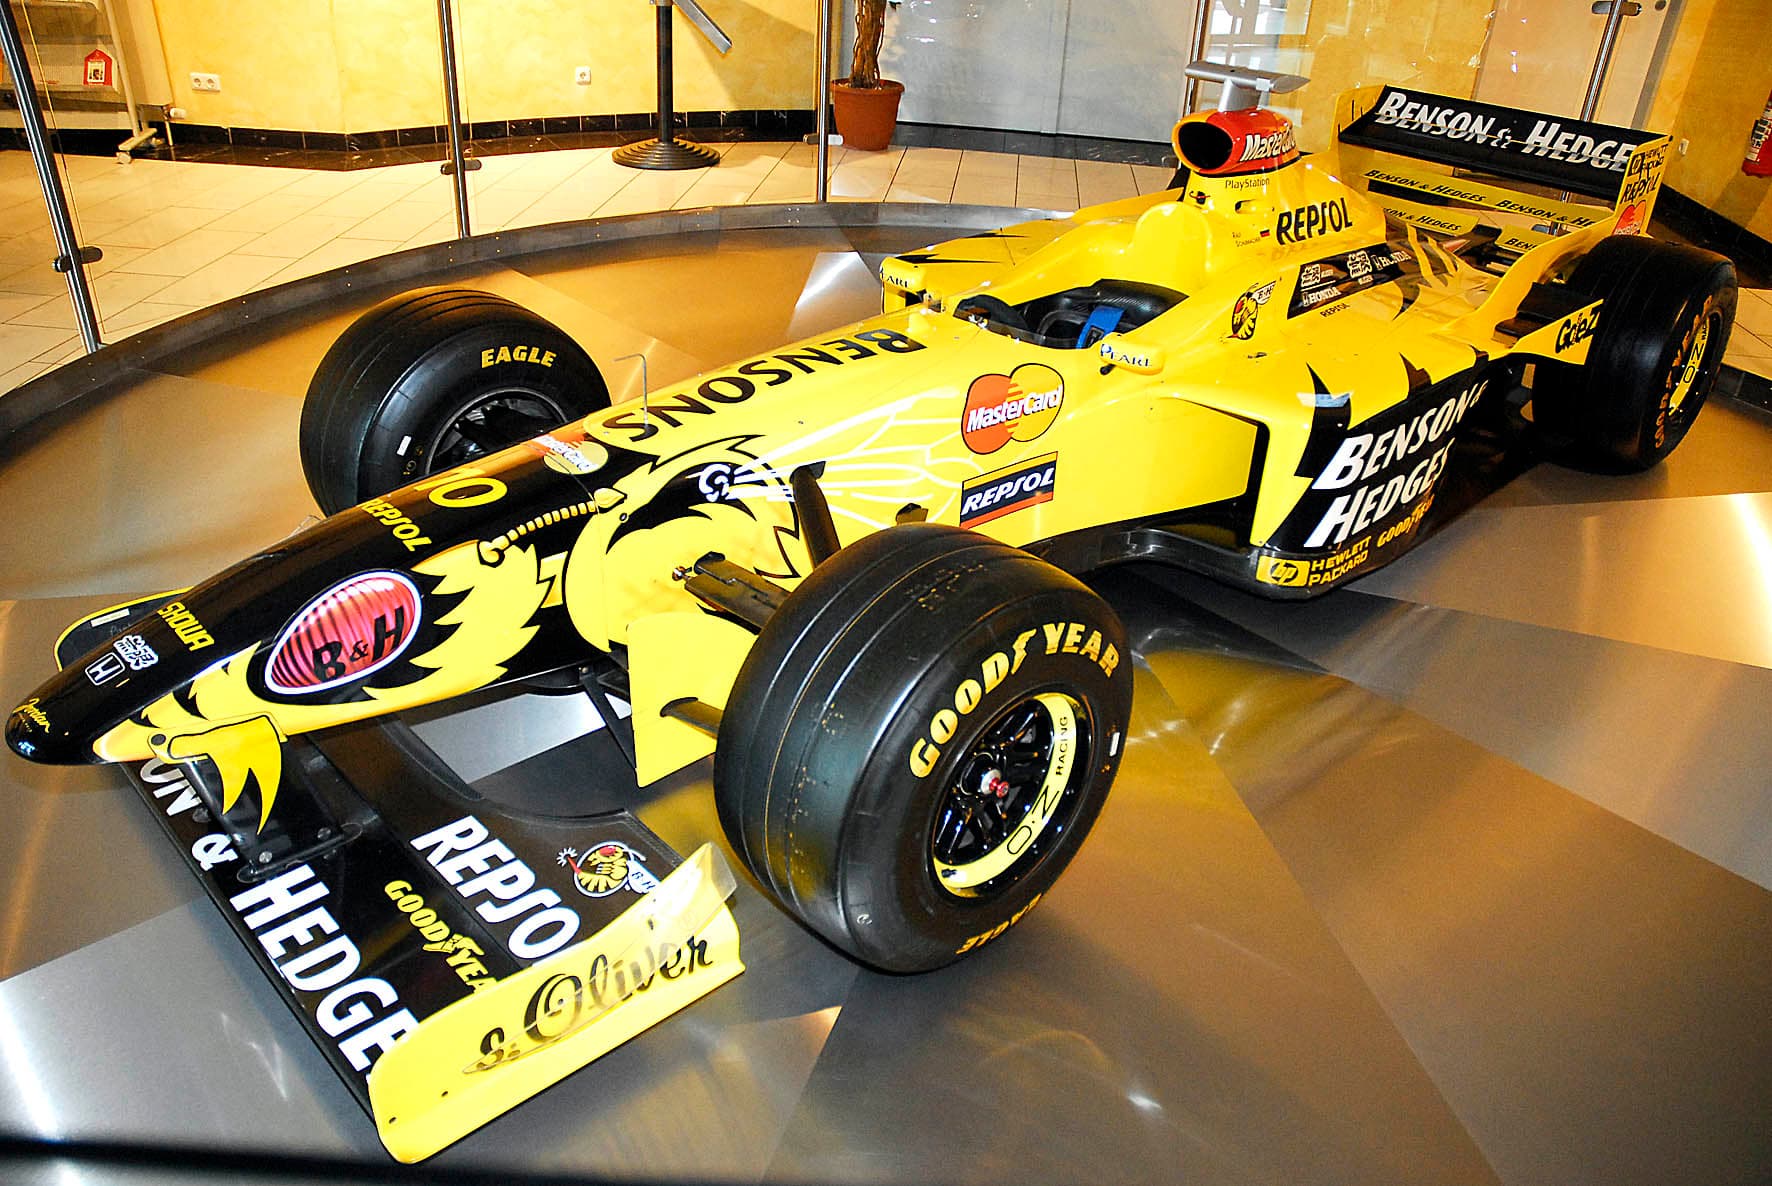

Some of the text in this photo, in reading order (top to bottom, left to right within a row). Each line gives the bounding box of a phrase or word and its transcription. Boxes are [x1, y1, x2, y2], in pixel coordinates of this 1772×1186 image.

[1375, 92, 1497, 145] BENSON
[1522, 120, 1637, 173] HEDGE
[1225, 177, 1270, 192] PlayStation
[1364, 169, 1597, 227] BENSON & HEDGES BENSON & HE
[1276, 197, 1353, 246] REPSOL
[1416, 215, 1462, 232] HEDGES
[1505, 238, 1538, 250] BEN
[1379, 251, 1412, 267] HONDA
[1309, 287, 1342, 304] HONDA
[481, 345, 557, 369] EAGLE
[1100, 343, 1153, 368] PEARL
[602, 328, 927, 442] BENSONS
[966, 384, 1064, 434] MasterCard
[1312, 387, 1475, 490] BENSON
[961, 467, 1055, 516] REPSOL
[1304, 437, 1456, 548] HEDGES
[357, 498, 432, 552] REPSOL
[1308, 549, 1369, 587] PACKARD
[1311, 536, 1372, 571] HEWLETT
[156, 601, 215, 652] SHOWA
[12, 697, 51, 734] Jordan
[909, 621, 1120, 779] GOODYEAR
[1055, 716, 1069, 777] RACING
[410, 815, 581, 960] REPSO
[140, 757, 419, 1073] ON & HEDGE
[384, 880, 498, 994] GOODYEA
